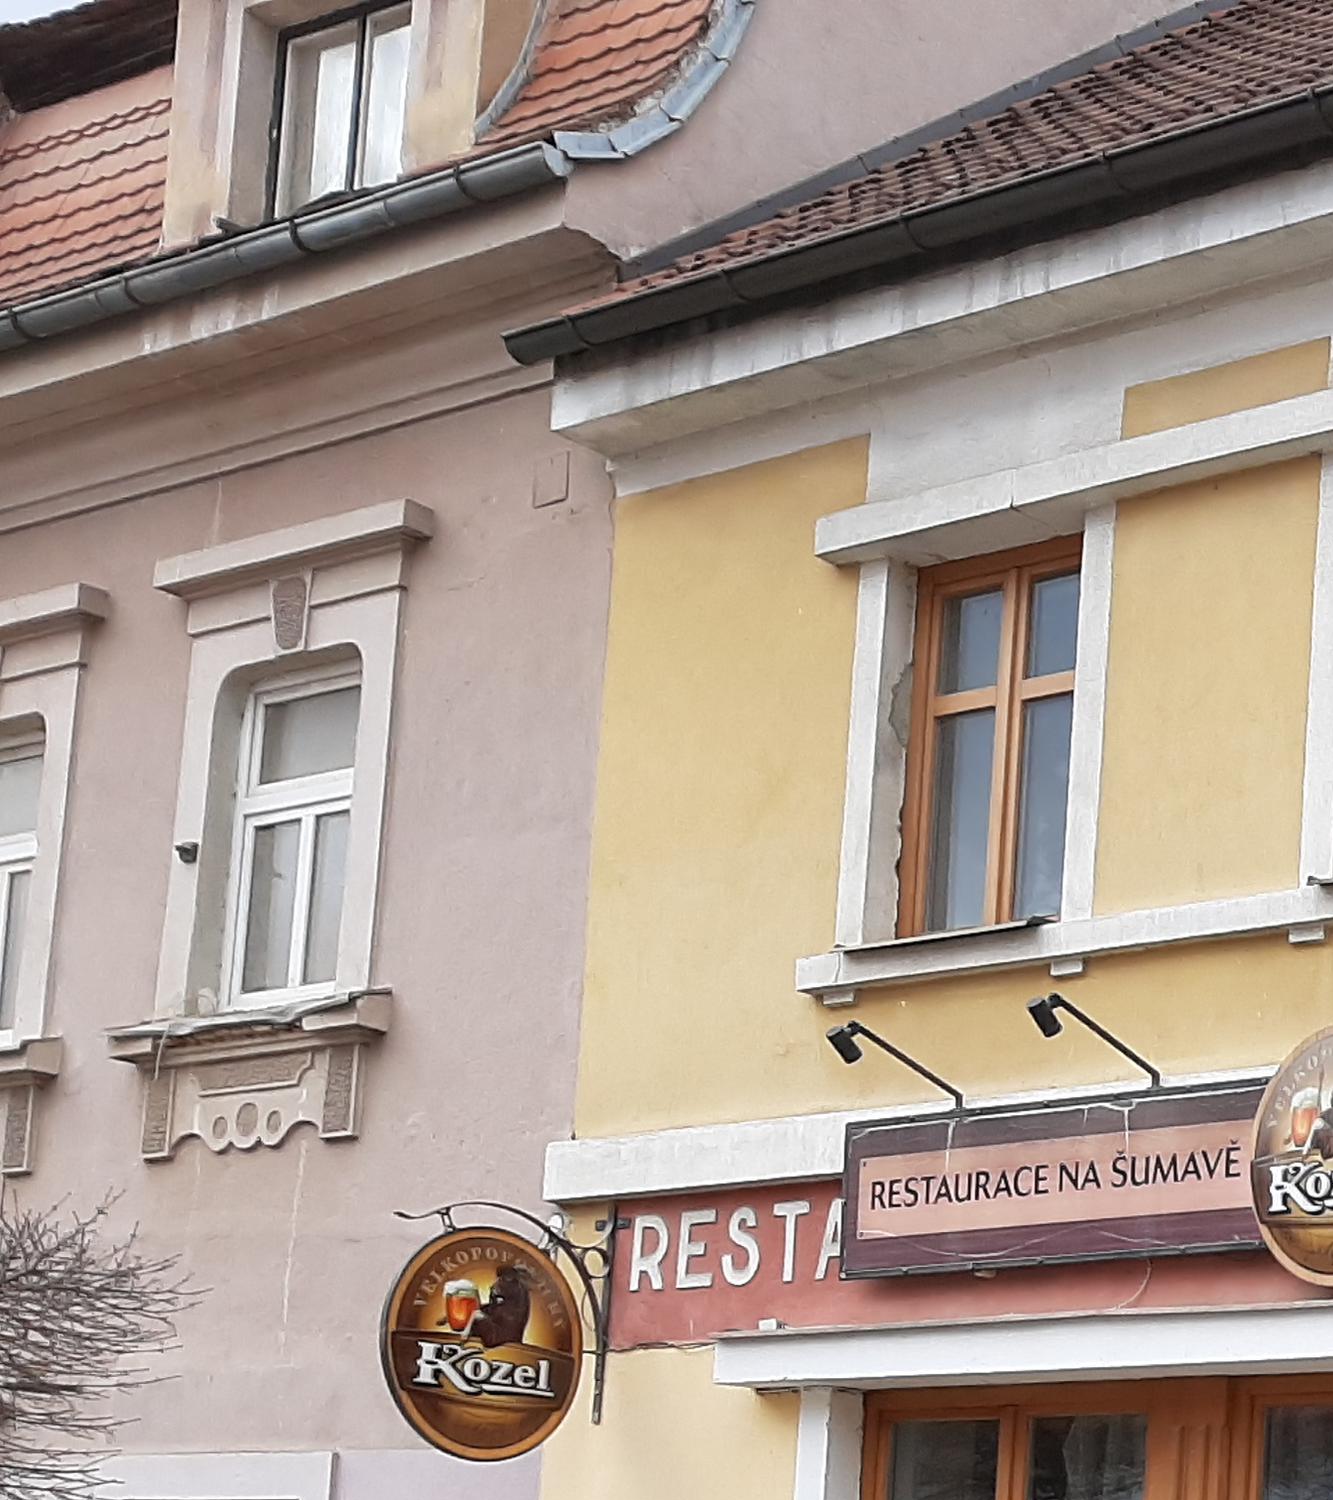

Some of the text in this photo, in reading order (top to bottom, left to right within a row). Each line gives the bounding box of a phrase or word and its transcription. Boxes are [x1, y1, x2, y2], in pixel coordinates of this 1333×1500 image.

[870, 1140, 1242, 1210] RESTAURACE NA ŠUMAVĚ
[412, 1341, 555, 1398] Kozel
